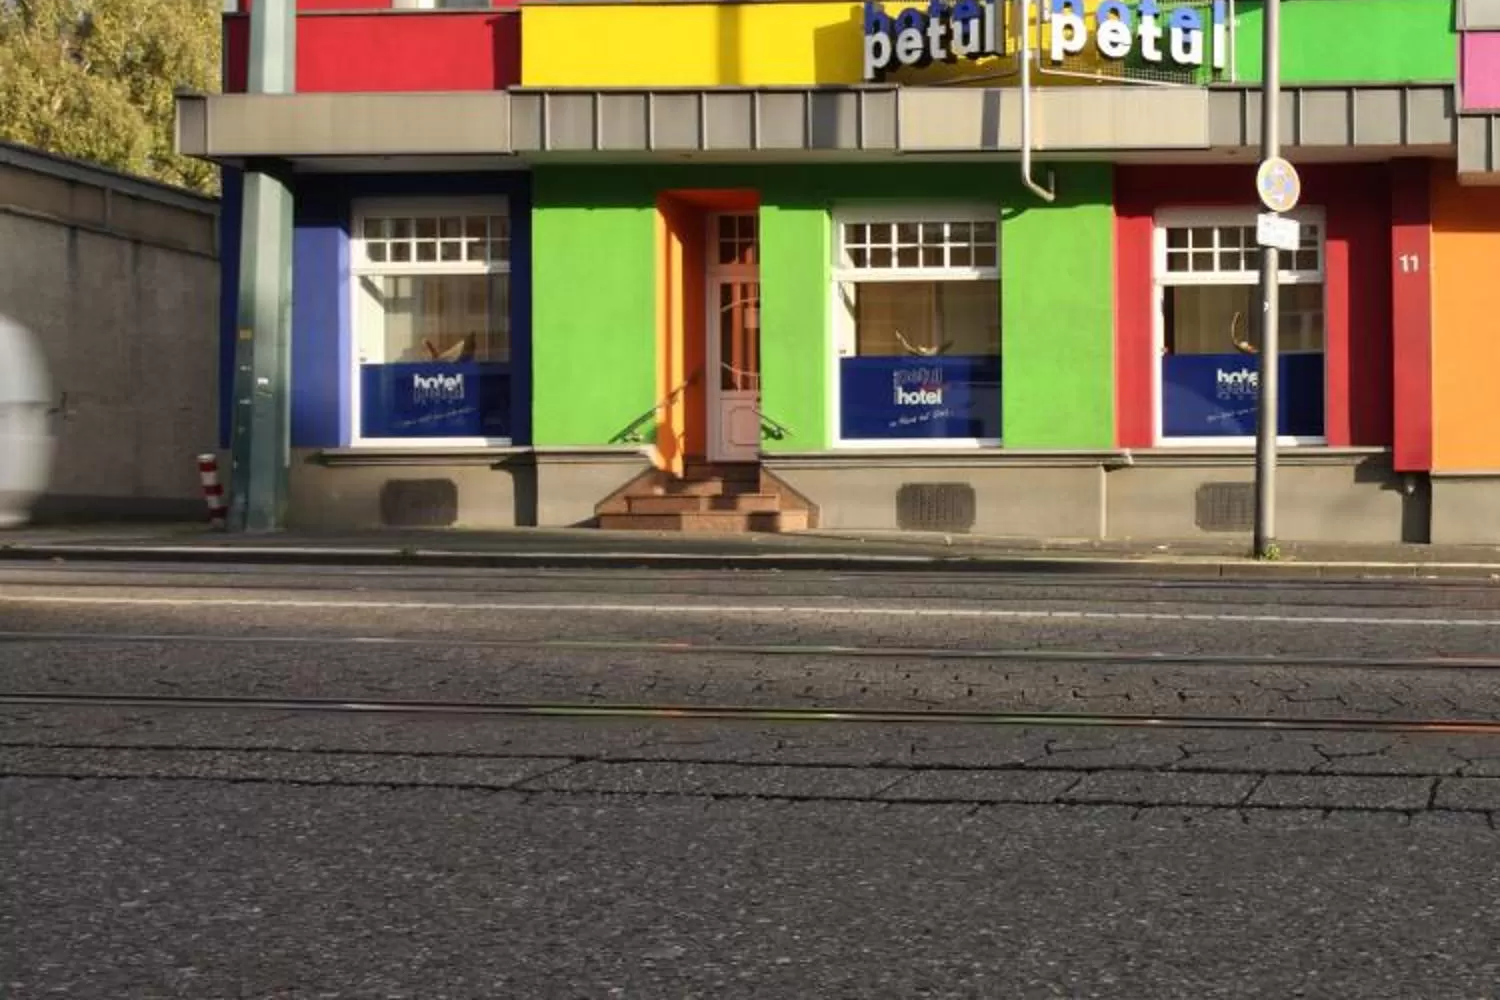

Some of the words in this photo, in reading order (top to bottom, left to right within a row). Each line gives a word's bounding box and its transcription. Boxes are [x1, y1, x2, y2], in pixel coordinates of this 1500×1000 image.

[865, 0, 995, 80] petul
[1051, 6, 1225, 69] petul
[1400, 254, 1418, 272] 11
[1217, 368, 1260, 387] hote
[897, 386, 942, 405] hotel
